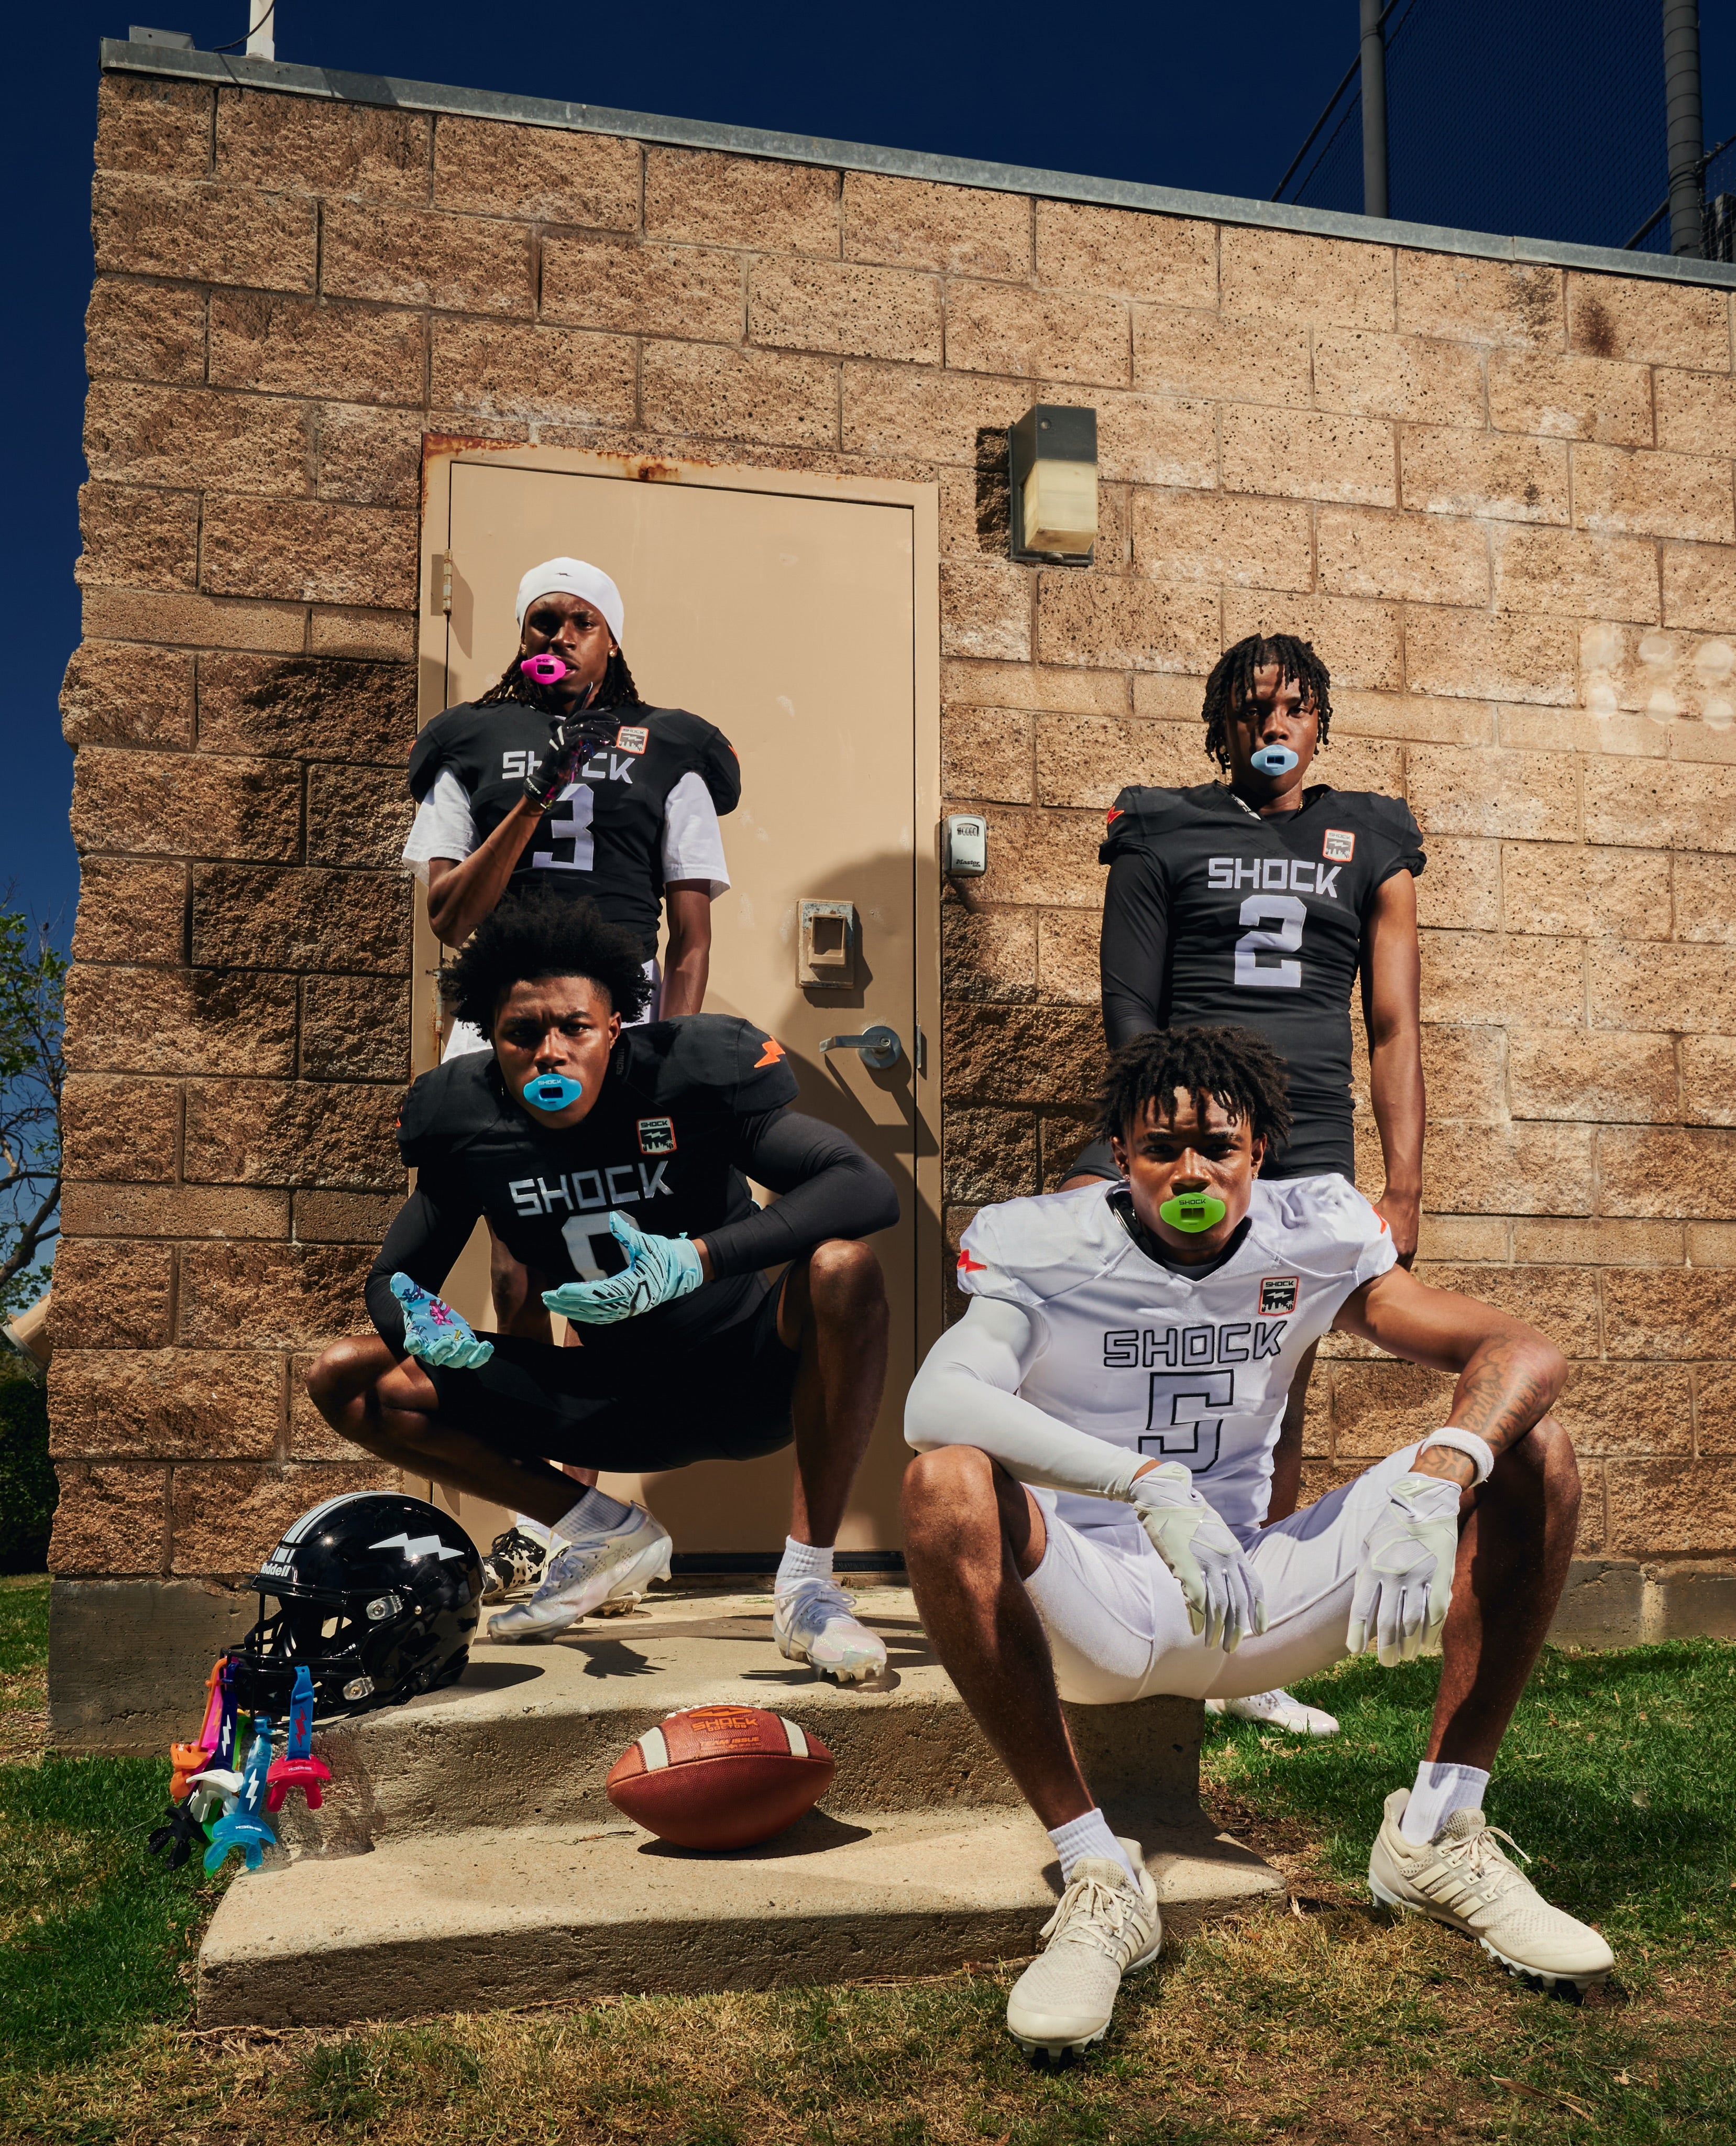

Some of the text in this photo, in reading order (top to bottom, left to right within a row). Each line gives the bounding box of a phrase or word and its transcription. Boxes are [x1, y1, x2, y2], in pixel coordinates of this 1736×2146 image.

[502, 751, 635, 784] SHCK
[533, 783, 594, 871] 3
[1208, 858, 1343, 899] SHOCK
[1234, 895, 1307, 988] 2
[509, 1160, 674, 1217] SHOCK
[1104, 1320, 1288, 1368] SHOCK
[1138, 1368, 1234, 1473] 5
[692, 1717, 759, 1732] SHOCK
